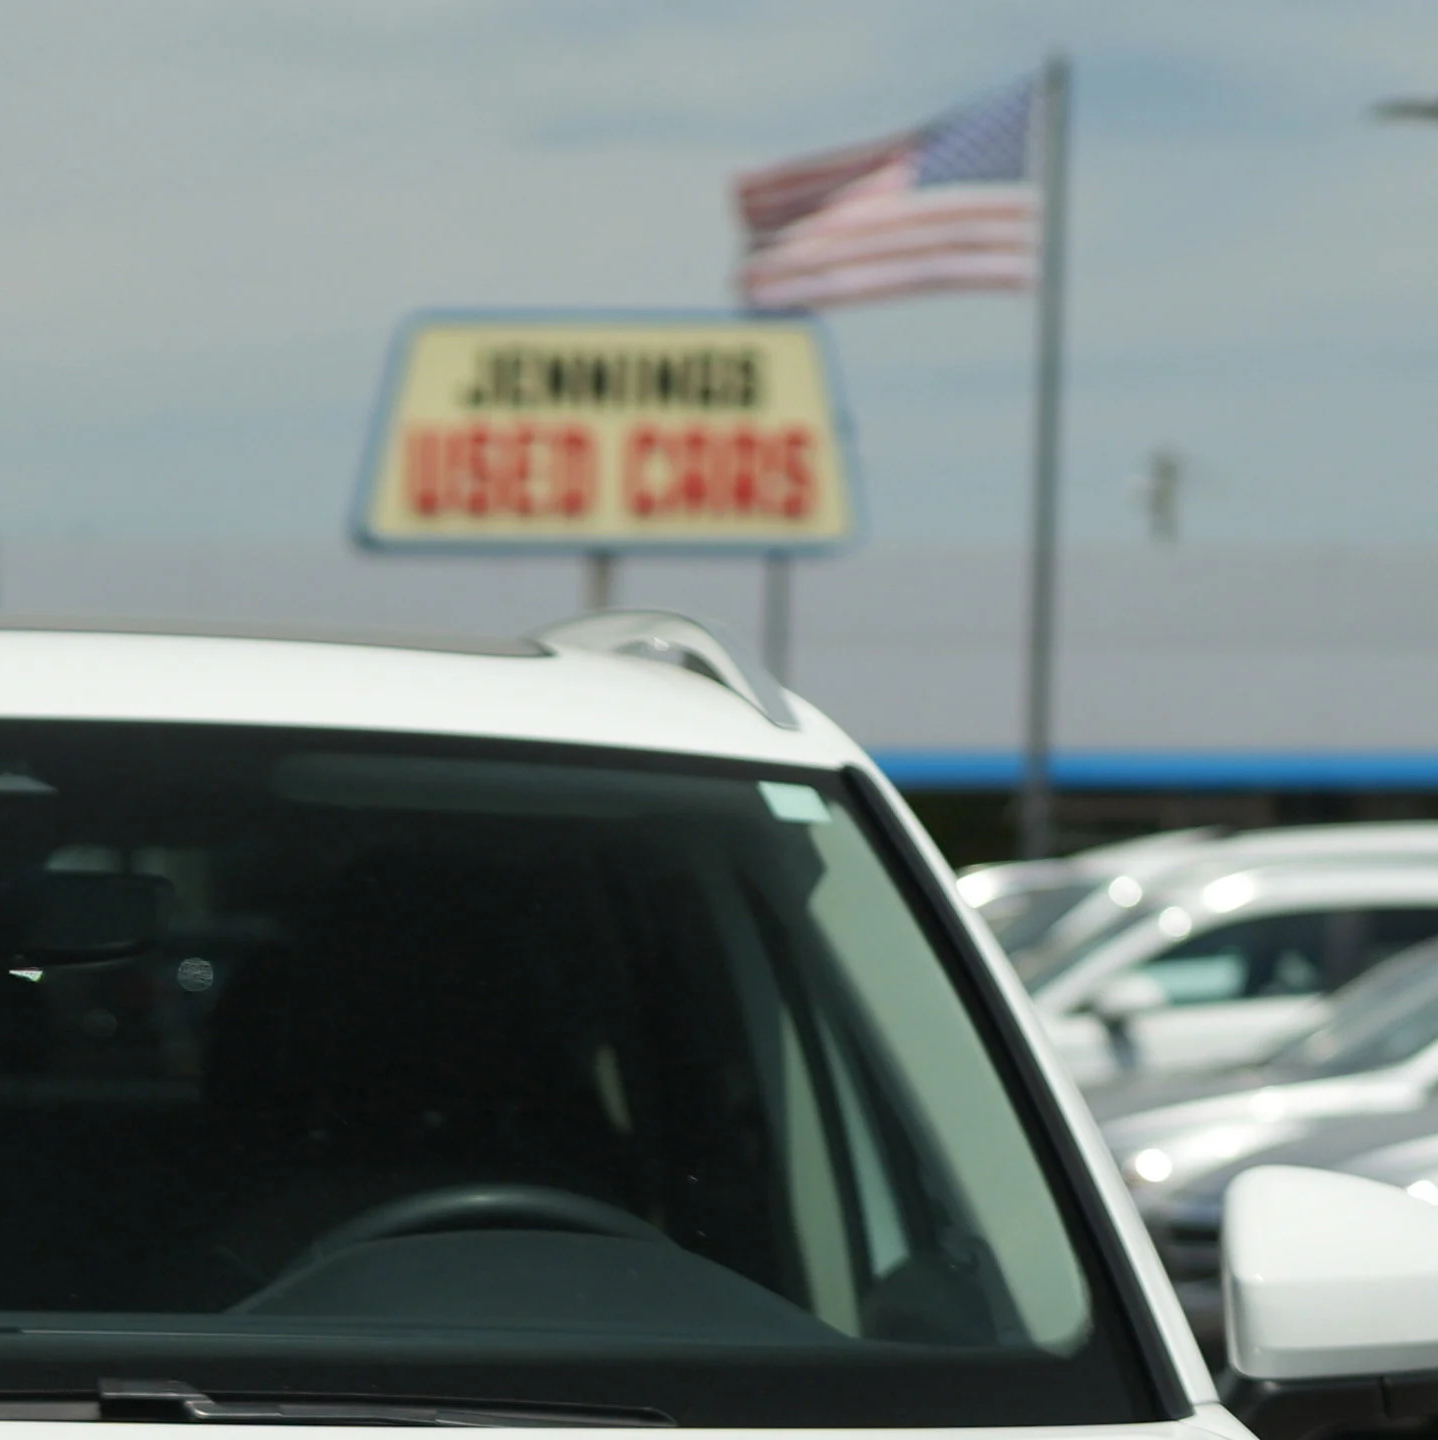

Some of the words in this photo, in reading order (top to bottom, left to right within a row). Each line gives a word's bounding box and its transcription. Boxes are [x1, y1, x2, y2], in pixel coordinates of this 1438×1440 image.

[462, 346, 764, 409] JENNINGS
[408, 424, 597, 518] USED
[627, 424, 819, 518] CARS
